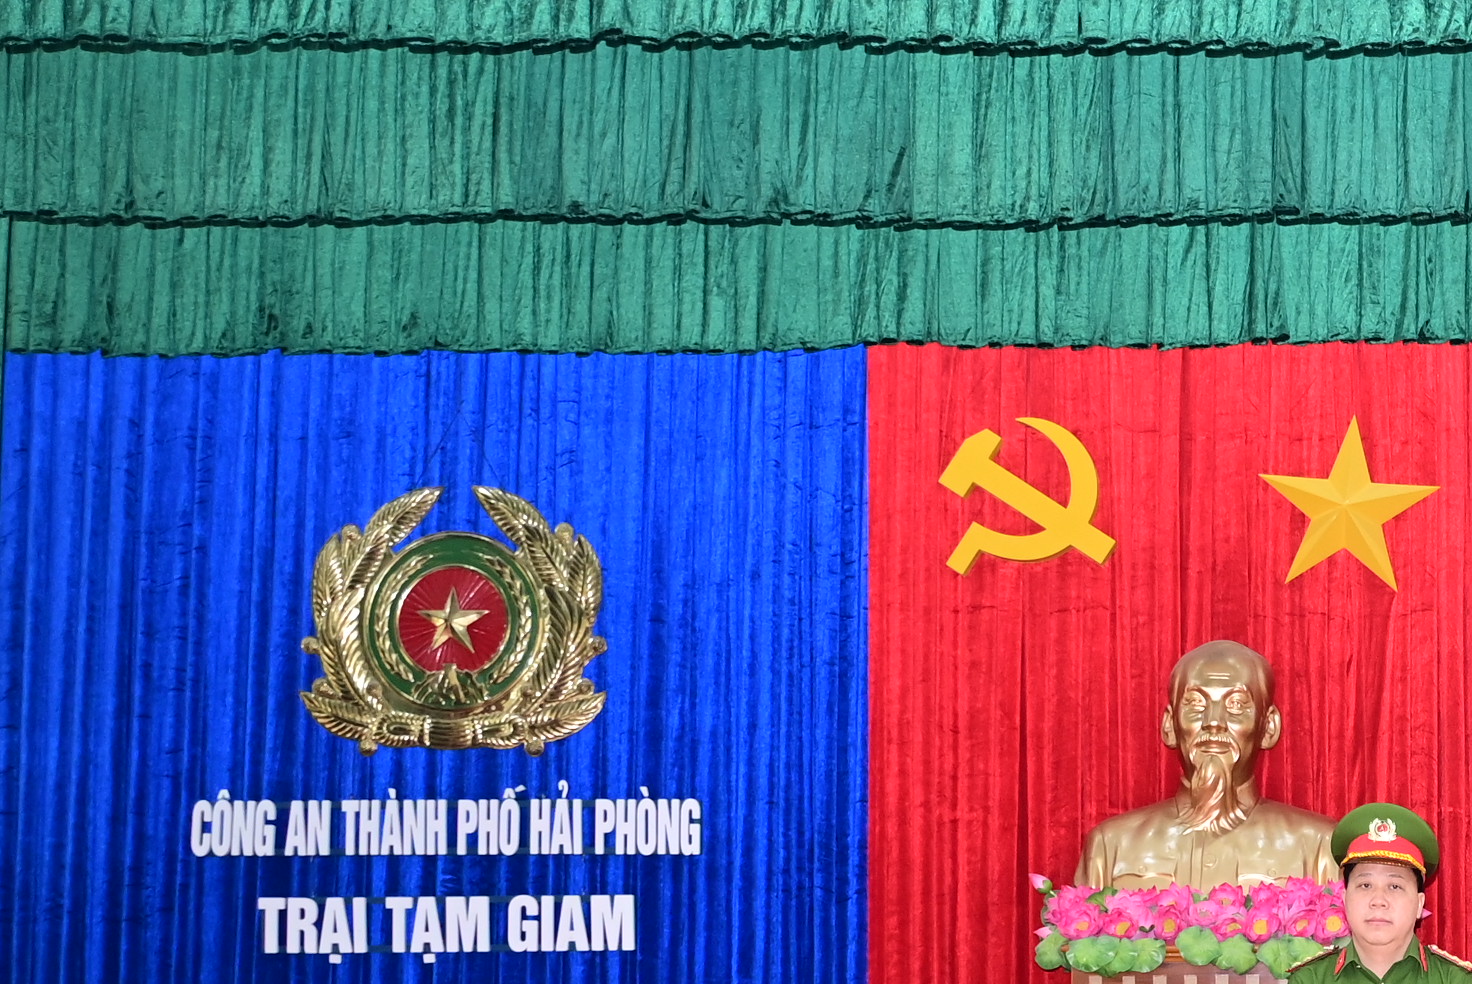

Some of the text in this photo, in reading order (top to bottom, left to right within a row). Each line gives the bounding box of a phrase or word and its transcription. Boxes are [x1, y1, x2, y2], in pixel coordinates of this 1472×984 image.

[191, 780, 700, 856] CÔNG AN THÀNH PHỐ HẢI PHÒNG
[258, 895, 634, 963] TRẠI TẠM GIAM
